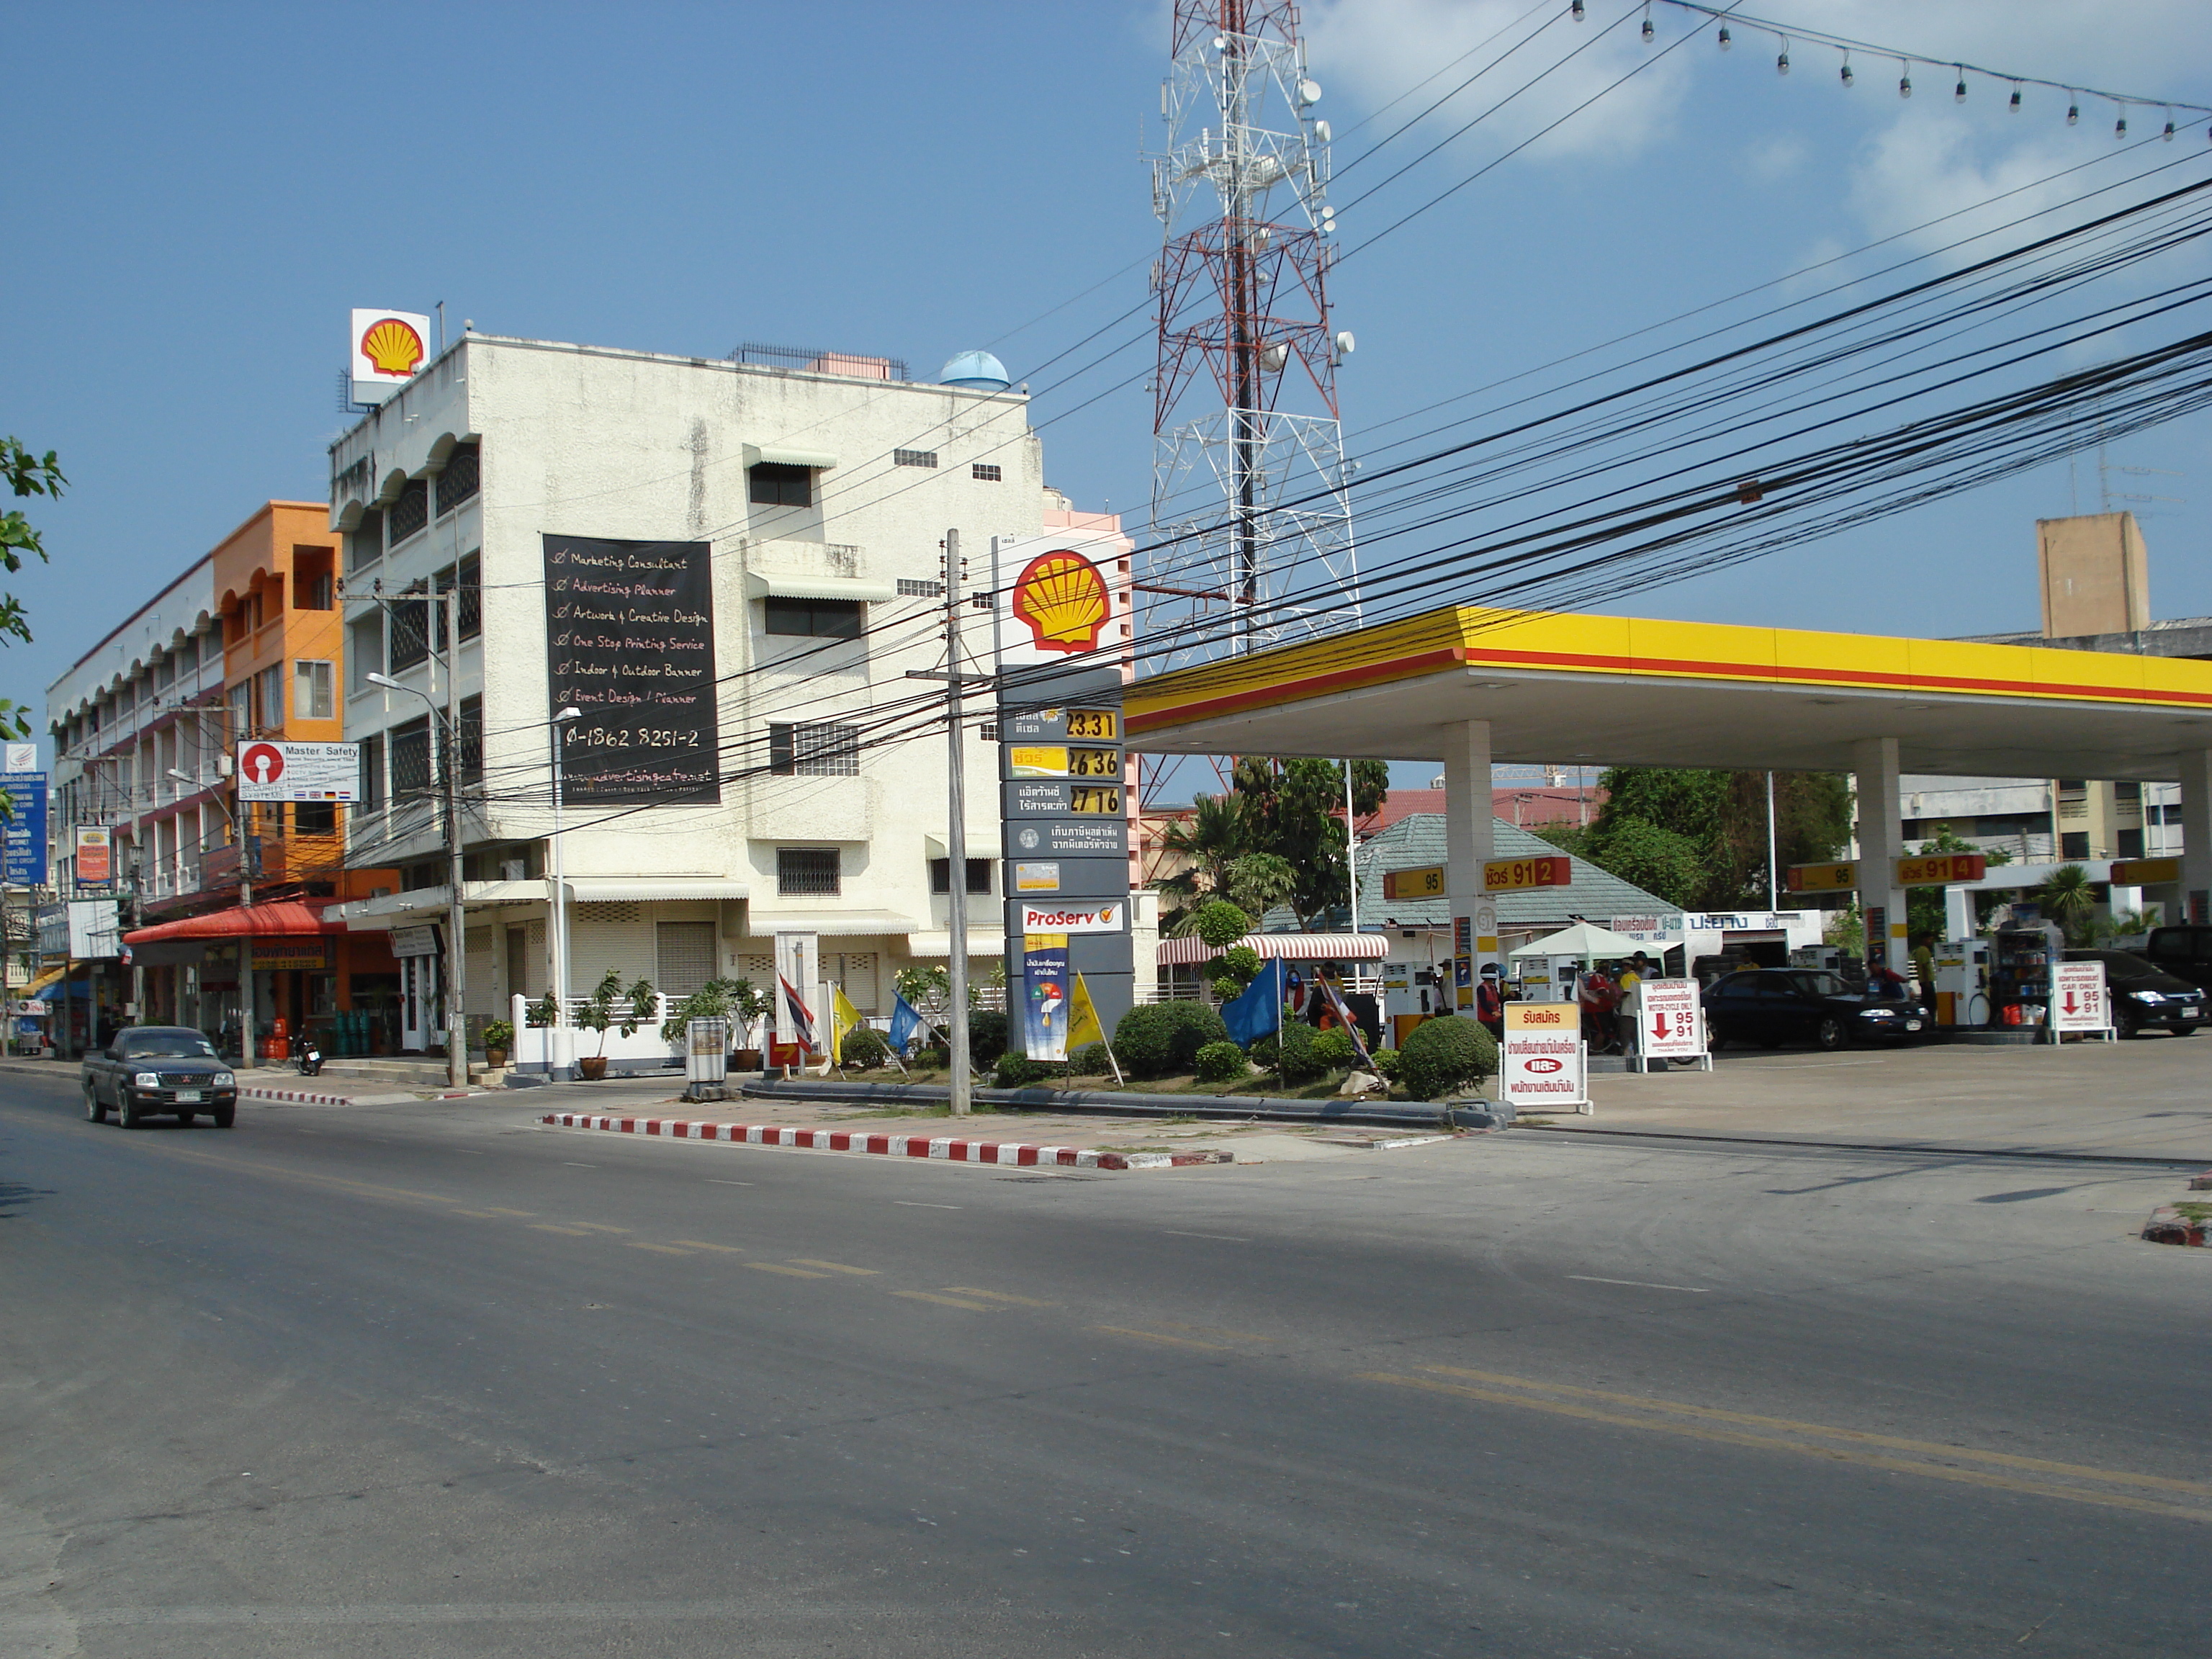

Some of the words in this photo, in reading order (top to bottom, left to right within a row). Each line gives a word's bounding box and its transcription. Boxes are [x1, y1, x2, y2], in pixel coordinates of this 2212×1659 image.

[571, 553, 624, 571] Marketing
[628, 554, 688, 570] Consultant
[573, 578, 631, 598] Advertising
[635, 584, 676, 595] Planner
[573, 606, 616, 621] Artwork
[629, 608, 670, 622] Creative
[674, 608, 708, 626] Design
[574, 635, 593, 647] One
[598, 636, 621, 651] Stop
[625, 637, 666, 653] Printing
[670, 638, 705, 649] Service
[575, 661, 608, 675] Indoor
[622, 664, 660, 676] Outdoor
[665, 663, 702, 677] Banner
[576, 689, 606, 702] Event
[608, 689, 642, 707] Design
[655, 692, 696, 703] Planner
[1016, 722, 1040, 733] ดีเซล
[1067, 714, 1112, 736] 23.31
[638, 727, 698, 747] 8251-2
[285, 746, 320, 755] Master
[326, 747, 358, 757] Safety
[1486, 868, 1508, 886] ชัวร์
[1514, 863, 1532, 885] 91
[1540, 863, 1551, 881] 2
[1902, 866, 1922, 880] ชัวร์
[1927, 860, 1948, 878] 91
[1958, 860, 1969, 876] 4
[1426, 873, 1438, 890] 95
[1836, 869, 1848, 883] 95
[1027, 911, 1095, 926] ProServ
[1479, 915, 1493, 930] 91
[1690, 915, 1748, 929] ปะยาง
[2084, 991, 2099, 1001] 95
[2085, 1002, 2098, 1012] 91
[1524, 1010, 1560, 1023] รับสมัคร
[1676, 1012, 1693, 1023] 95
[1677, 1025, 1693, 1037] 91
[1531, 1060, 1556, 1071] และ
[1511, 1079, 1574, 1093] พนักงานเติมน้ำมัน
